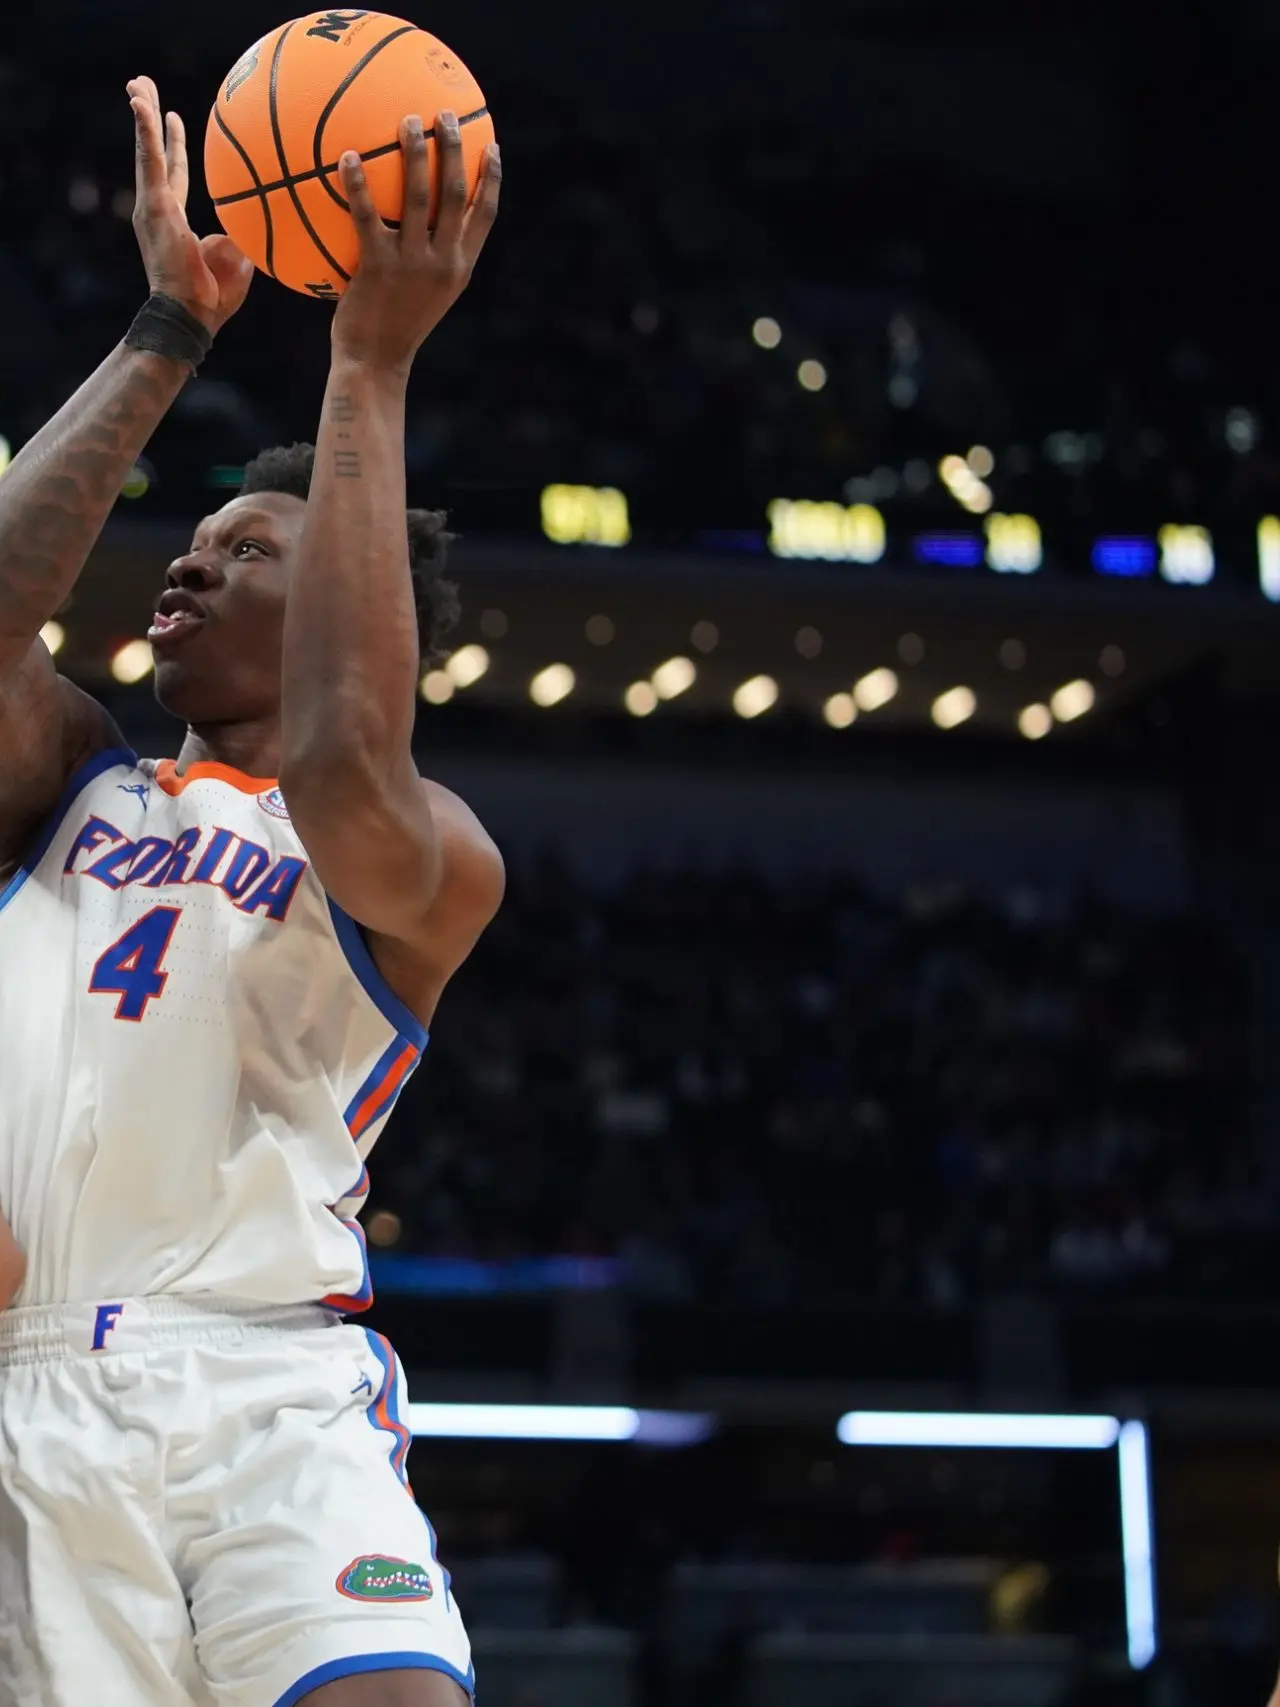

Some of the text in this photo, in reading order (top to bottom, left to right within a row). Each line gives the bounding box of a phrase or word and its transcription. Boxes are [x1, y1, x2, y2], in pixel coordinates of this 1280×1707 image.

[63, 814, 308, 923] FLORIDA
[88, 904, 183, 1023] 4
[89, 1303, 124, 1351] F
